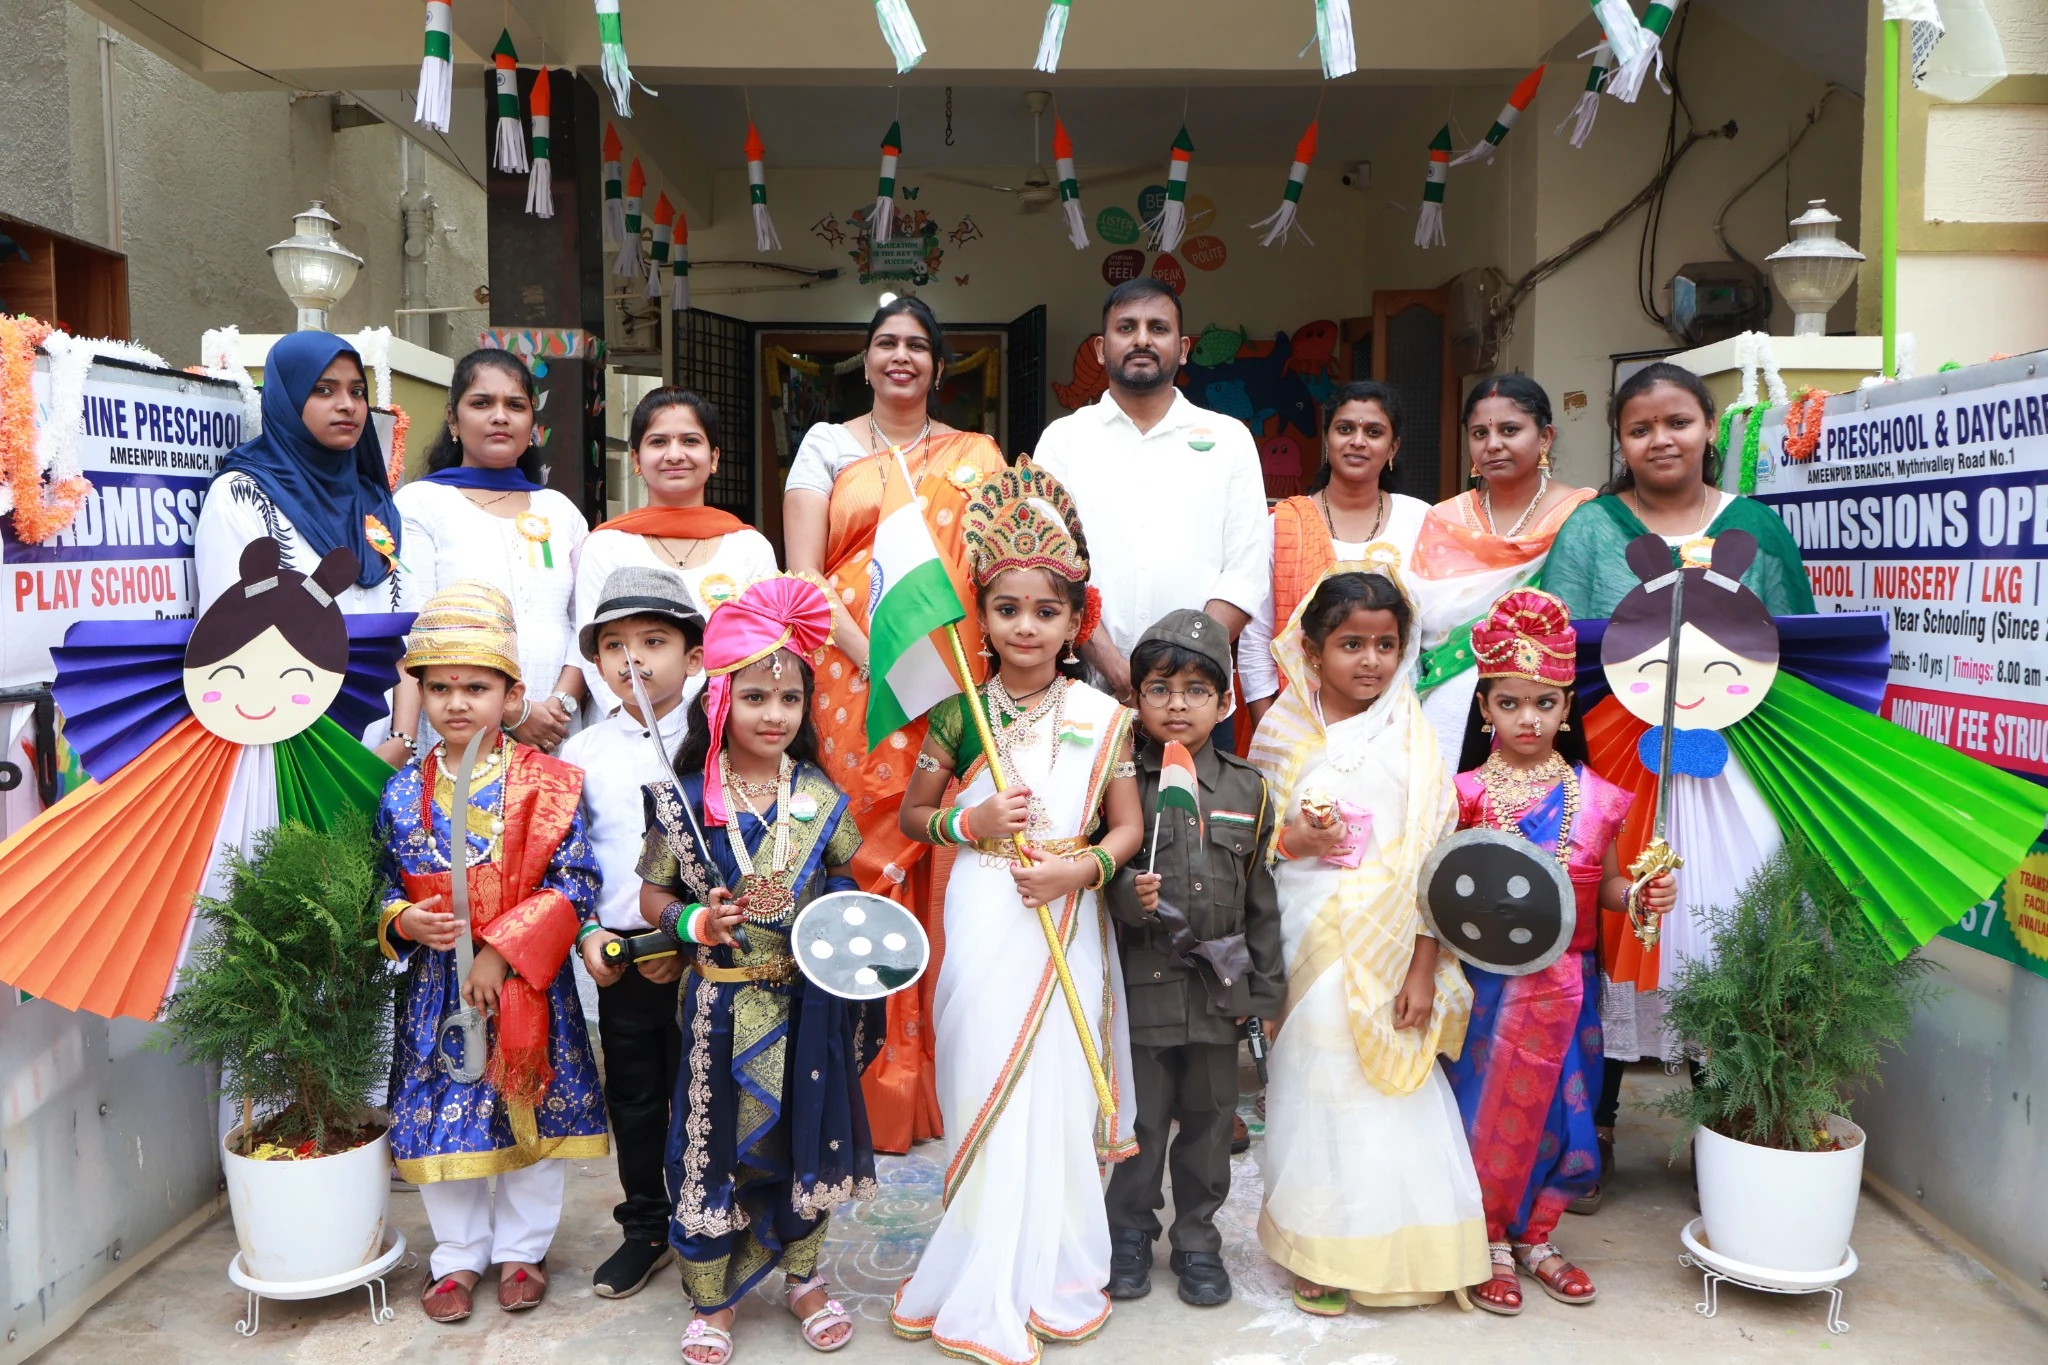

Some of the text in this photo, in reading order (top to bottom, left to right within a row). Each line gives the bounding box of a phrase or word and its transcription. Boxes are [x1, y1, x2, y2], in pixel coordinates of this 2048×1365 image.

[1101, 214, 1134, 230] LISTEN
[1110, 254, 1133, 262] explain
[1191, 246, 1224, 265] POLITE
[1197, 238, 1209, 249] be
[1108, 268, 1136, 279] FEEL
[1152, 267, 1182, 281] SPEAK
[82, 394, 245, 449] HINE PRESCHOOL
[1827, 414, 1928, 461] PRESCHOOL
[1935, 410, 1949, 448] &
[110, 446, 168, 467] AMEENPUR
[171, 451, 212, 473] BRANCH,
[1807, 447, 2015, 484] AMEENPUR BRANCH, Mythrivalley Road No.1
[1768, 490, 1969, 550] DMISSIONS
[15, 565, 176, 612] PLAY SCHOOL
[1804, 565, 2023, 604] HOOL NURSERY LKG
[1893, 606, 1920, 632] Year
[1923, 607, 1986, 643] Schooling
[1992, 610, 2040, 644] (Since
[1889, 651, 1911, 671] onths
[1919, 652, 1929, 674] 10
[1930, 657, 1943, 679] yrs
[1953, 655, 1994, 685] Timings:
[1997, 659, 2021, 684] 8.00
[2024, 666, 2041, 687] am
[1891, 697, 1955, 745] MONTHLY
[1956, 708, 1989, 752] FEE
[2020, 870, 2048, 893] TRANS
